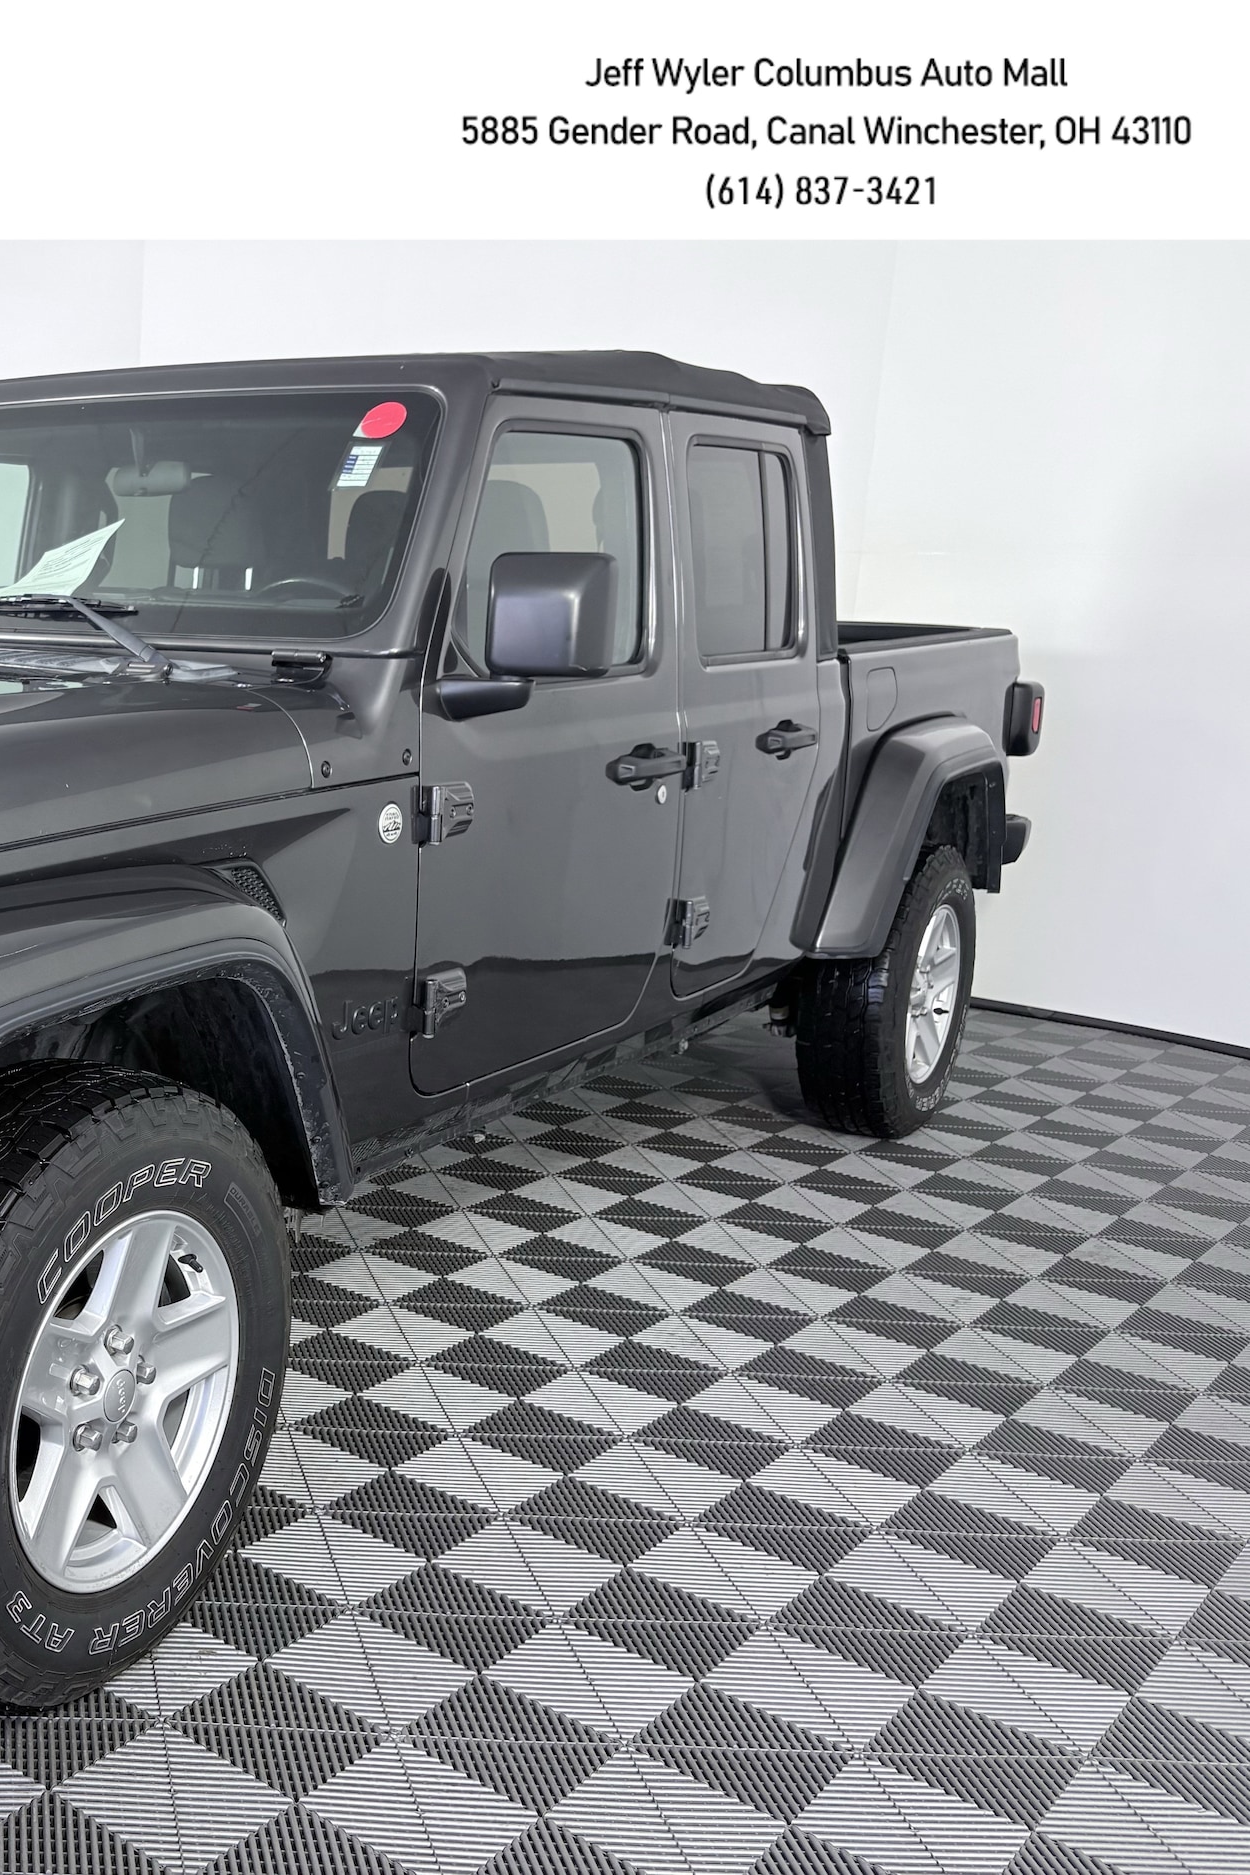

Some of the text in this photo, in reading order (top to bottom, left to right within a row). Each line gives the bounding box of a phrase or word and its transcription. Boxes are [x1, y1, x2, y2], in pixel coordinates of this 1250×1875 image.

[332, 996, 399, 1040] Jeep
[37, 1157, 212, 1305] COOPER
[6, 1367, 275, 1655] DISCOVERER AT3
